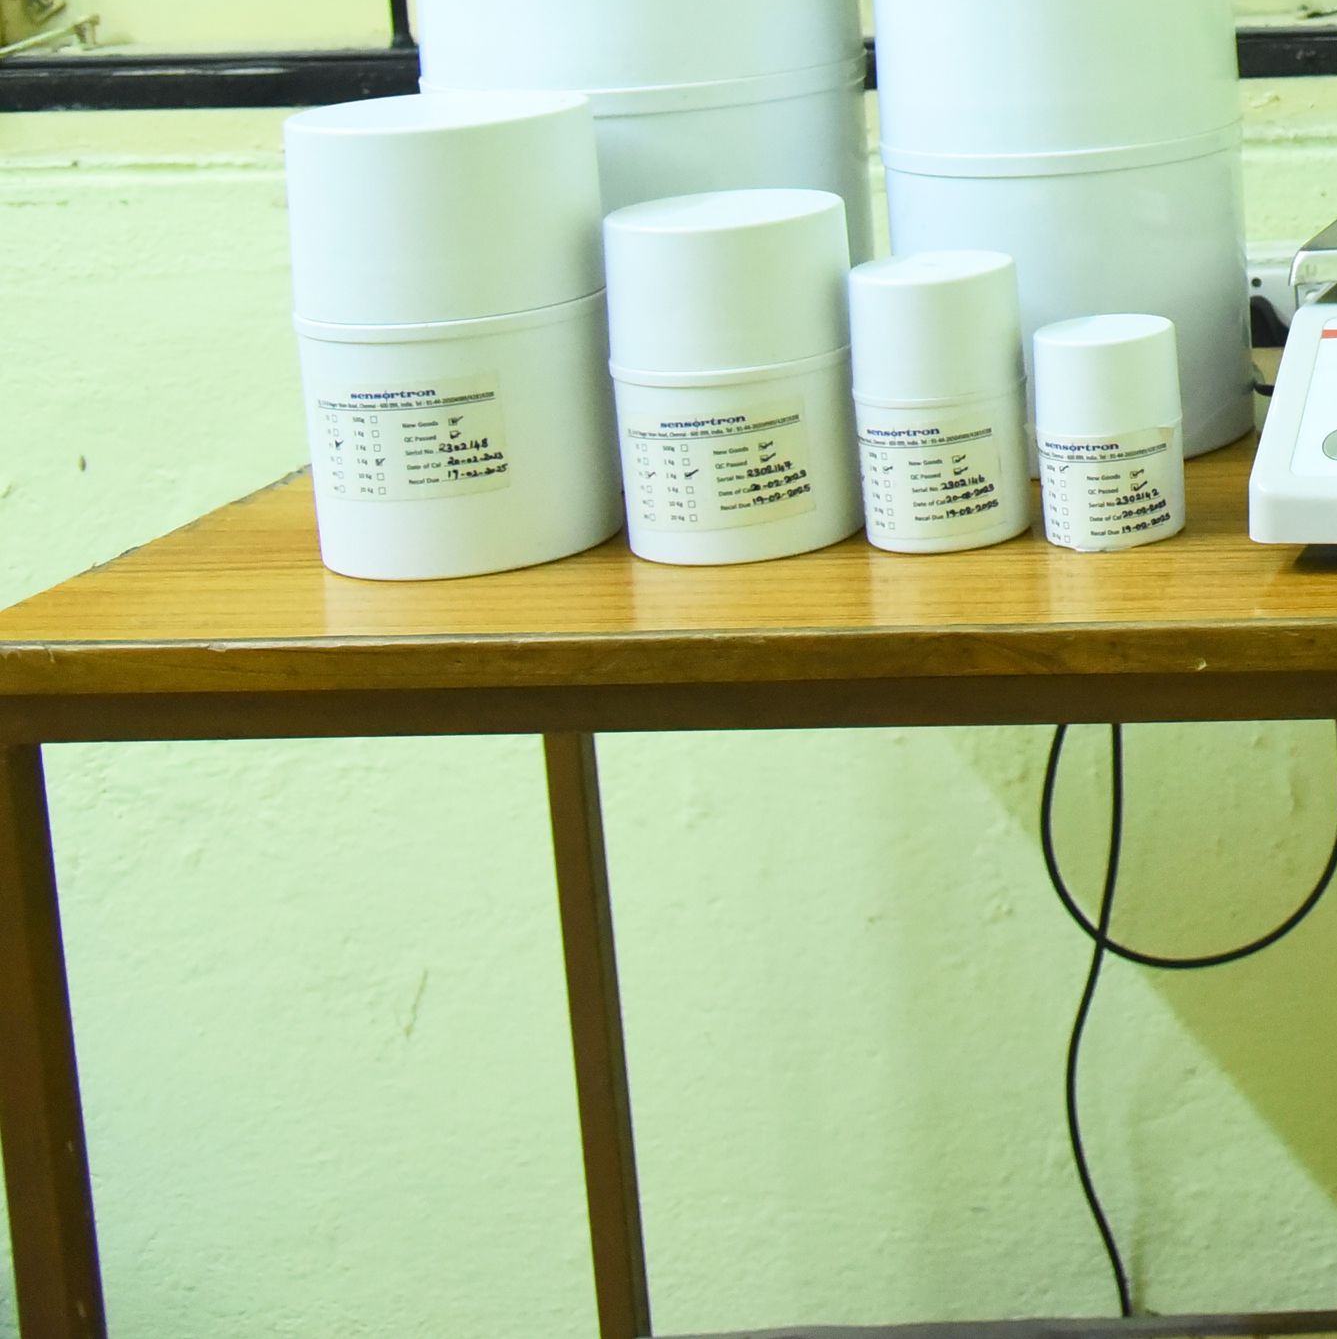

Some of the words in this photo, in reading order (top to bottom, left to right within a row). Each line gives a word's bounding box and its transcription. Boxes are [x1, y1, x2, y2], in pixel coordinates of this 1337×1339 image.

[350, 389, 436, 400] sensortron
[660, 414, 746, 429] sensortron
[867, 428, 940, 437] sensortron
[1045, 441, 1119, 452] sensortron
